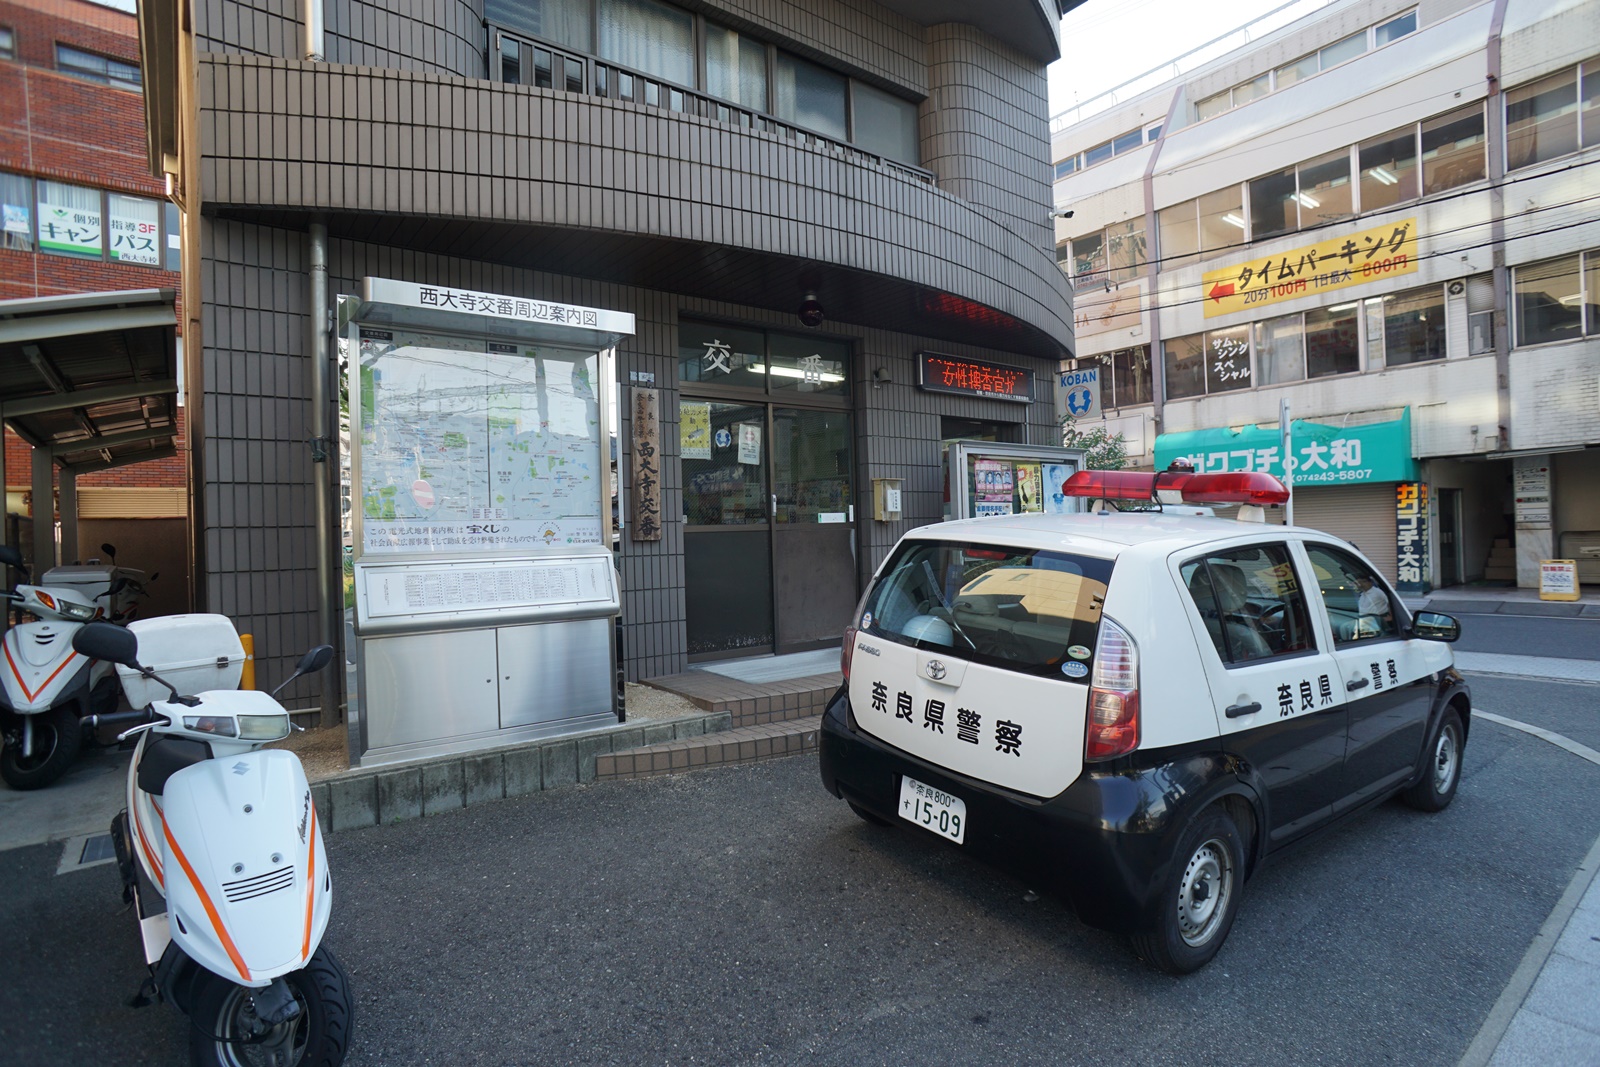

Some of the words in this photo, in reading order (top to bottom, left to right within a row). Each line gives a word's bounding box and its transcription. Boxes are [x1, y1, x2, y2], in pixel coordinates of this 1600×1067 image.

[138, 223, 156, 233] 3F
[1238, 222, 1410, 290] タイムパーキング
[419, 286, 598, 327] 西大寺交番周辺案内図
[1212, 337, 1233, 349] サム
[1218, 342, 1249, 359] シング
[1213, 360, 1235, 372] スペ
[1220, 367, 1250, 382] シャル
[1060, 370, 1097, 388] KOBAN
[680, 408, 708, 416] 犯カメラ
[637, 441, 660, 536] 西大寺交番
[466, 524, 500, 535] 宝くじ
[1397, 483, 1421, 583] ガクブチの大和
[1277, 674, 1333, 717] 奈良県
[1370, 658, 1398, 690] 警察
[871, 680, 1023, 757] 奈良県警察
[904, 799, 911, 811] す
[914, 798, 960, 838] 15-09
